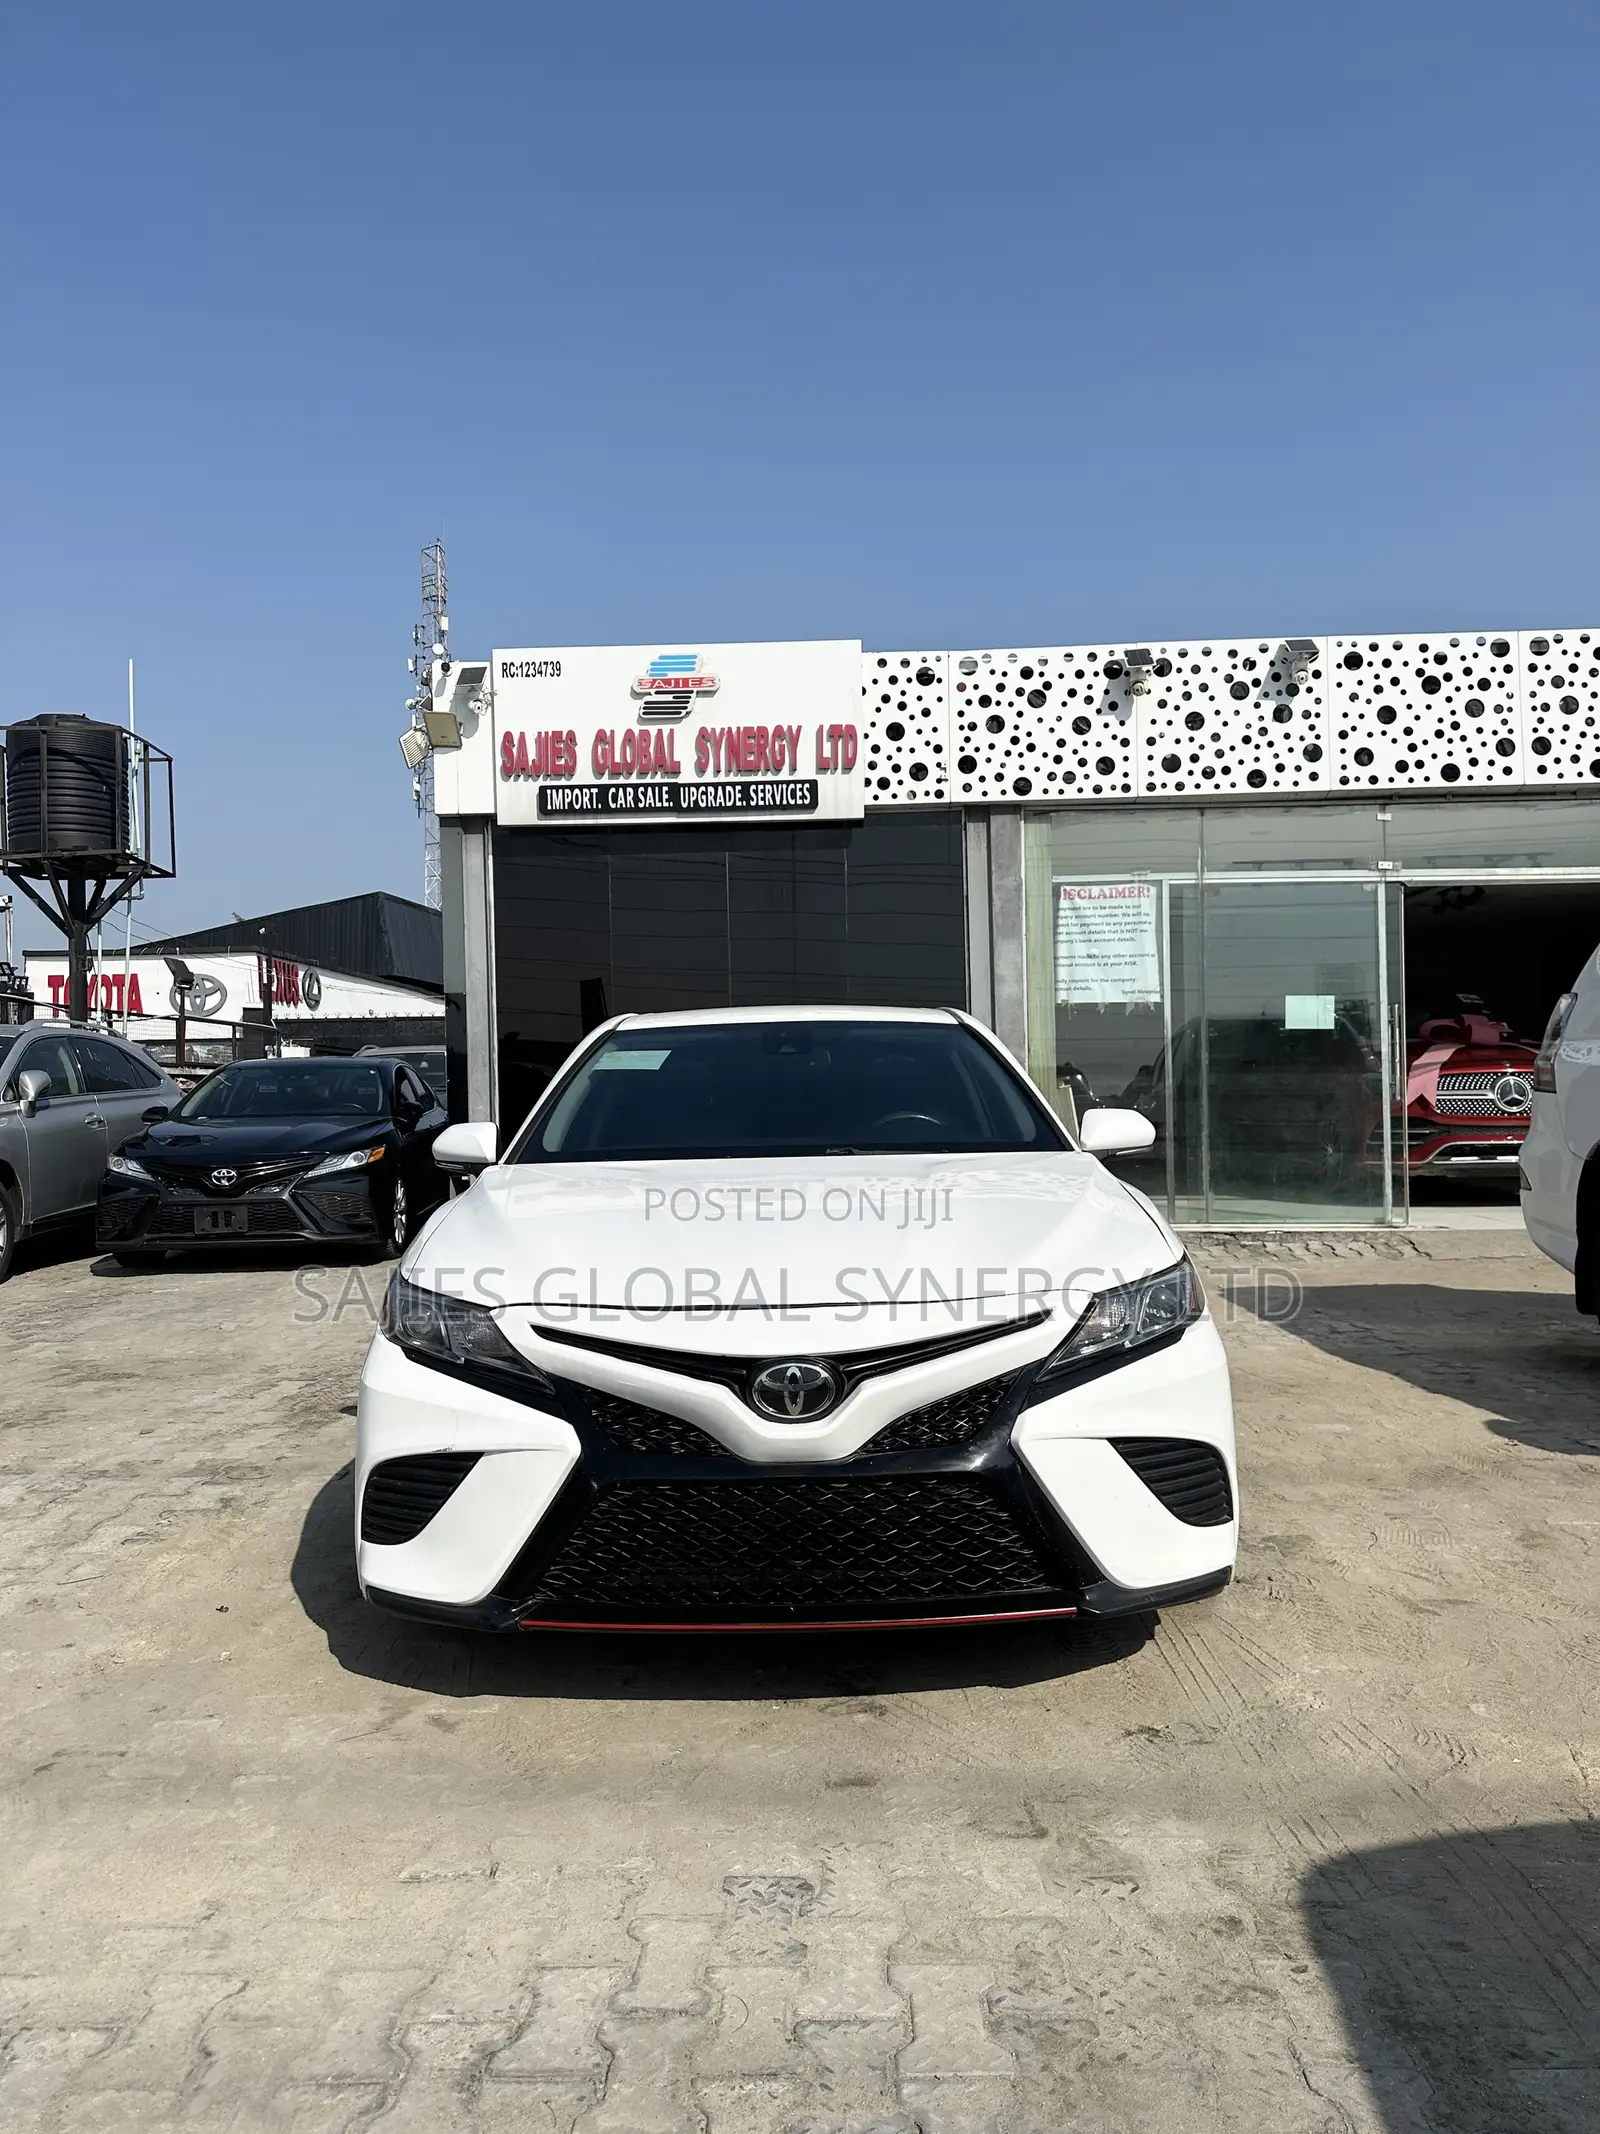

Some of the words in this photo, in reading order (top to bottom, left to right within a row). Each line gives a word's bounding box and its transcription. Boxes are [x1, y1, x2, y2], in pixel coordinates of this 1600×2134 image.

[502, 661, 562, 679] RC:1234739
[636, 677, 718, 688] SAJIES
[501, 730, 577, 778] SAJIES
[592, 728, 682, 776] GLOBAL
[695, 725, 803, 775] SYNERGY
[817, 724, 858, 772] LTD
[546, 787, 602, 811] IMPORT.
[608, 786, 635, 809] CAR
[637, 785, 674, 808] SALE.
[680, 784, 747, 808] UPGRADE.
[749, 783, 811, 806] SERVICES
[1061, 886, 1151, 900] ISCLAIMER!
